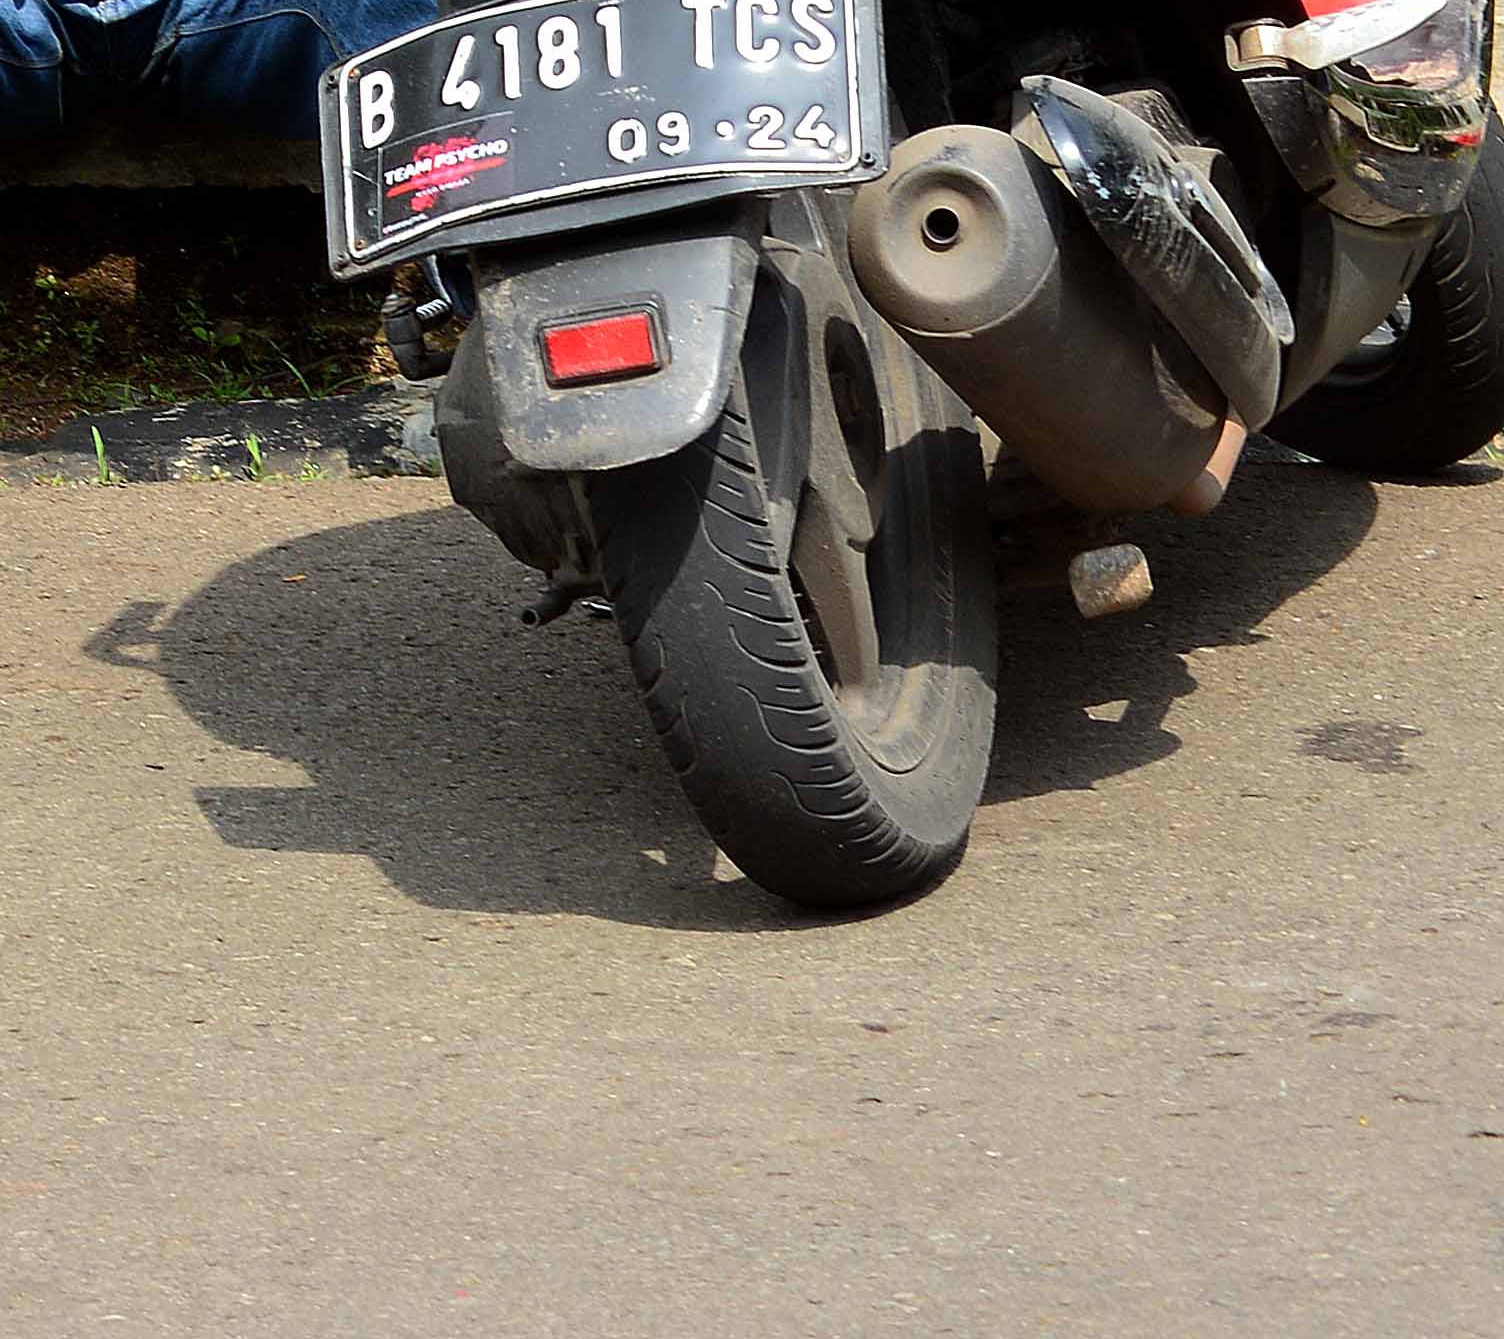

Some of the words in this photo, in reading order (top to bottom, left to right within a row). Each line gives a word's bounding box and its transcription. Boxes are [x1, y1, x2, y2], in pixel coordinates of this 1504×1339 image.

[359, 69, 395, 150] B
[441, 3, 624, 111] 4181
[384, 158, 433, 186] TEAM
[433, 138, 510, 169] PSYCHO
